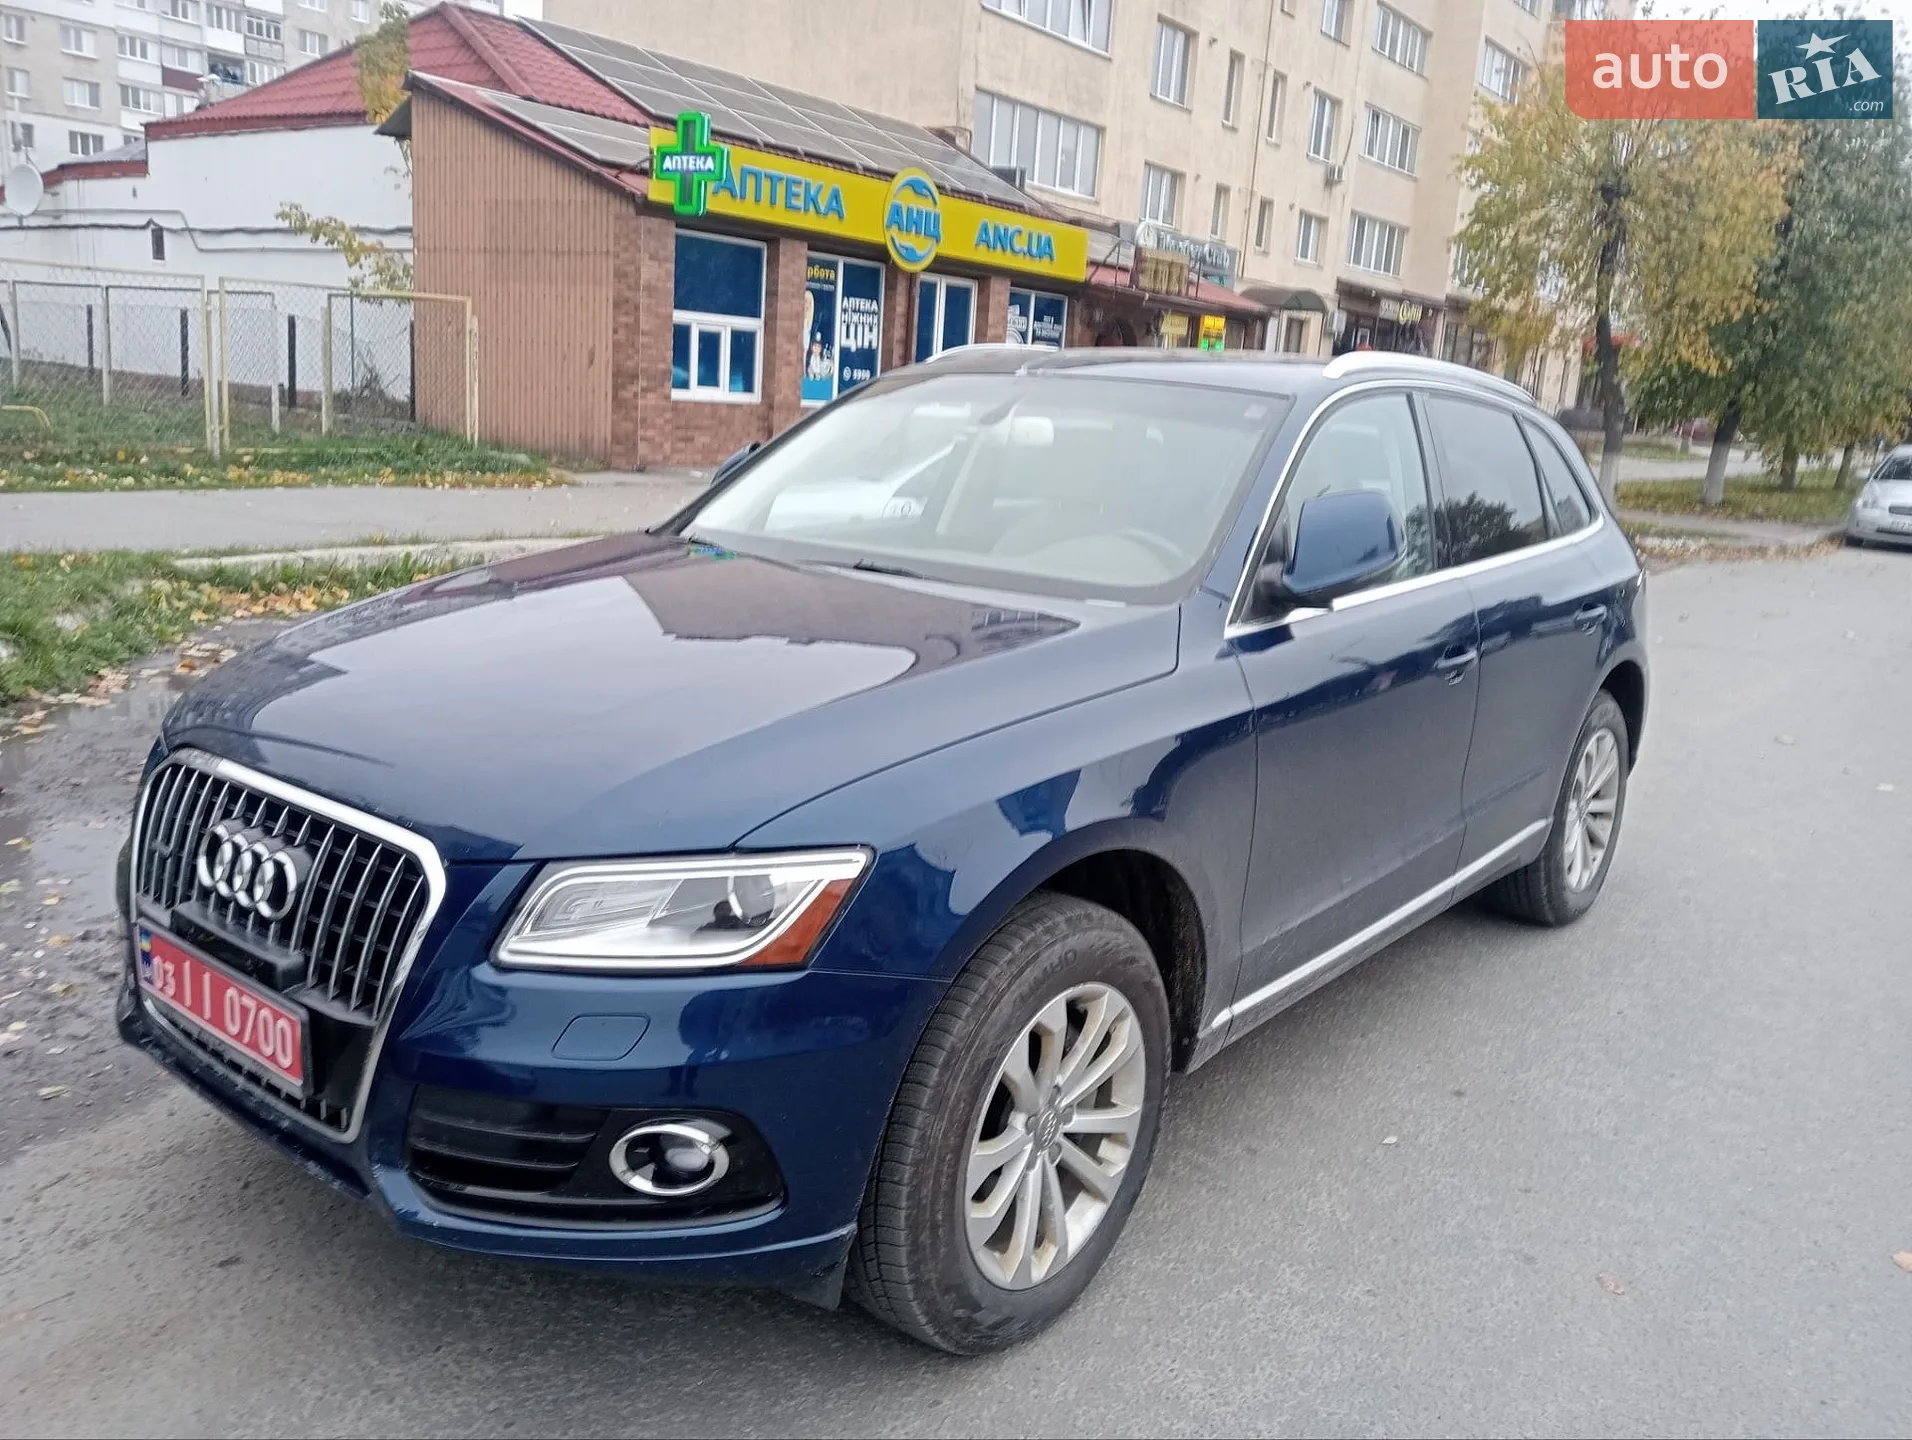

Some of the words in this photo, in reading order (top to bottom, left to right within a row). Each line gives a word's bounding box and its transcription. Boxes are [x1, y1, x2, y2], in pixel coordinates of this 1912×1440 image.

[661, 154, 715, 173] АПТЕКА
[712, 155, 846, 220] АПТЕКА
[886, 201, 942, 244] АНЦ
[974, 218, 1056, 263] ANC.UA
[842, 296, 878, 313] АПТЕКА
[841, 324, 878, 352] ЦІН
[223, 986, 293, 1069] 0700
